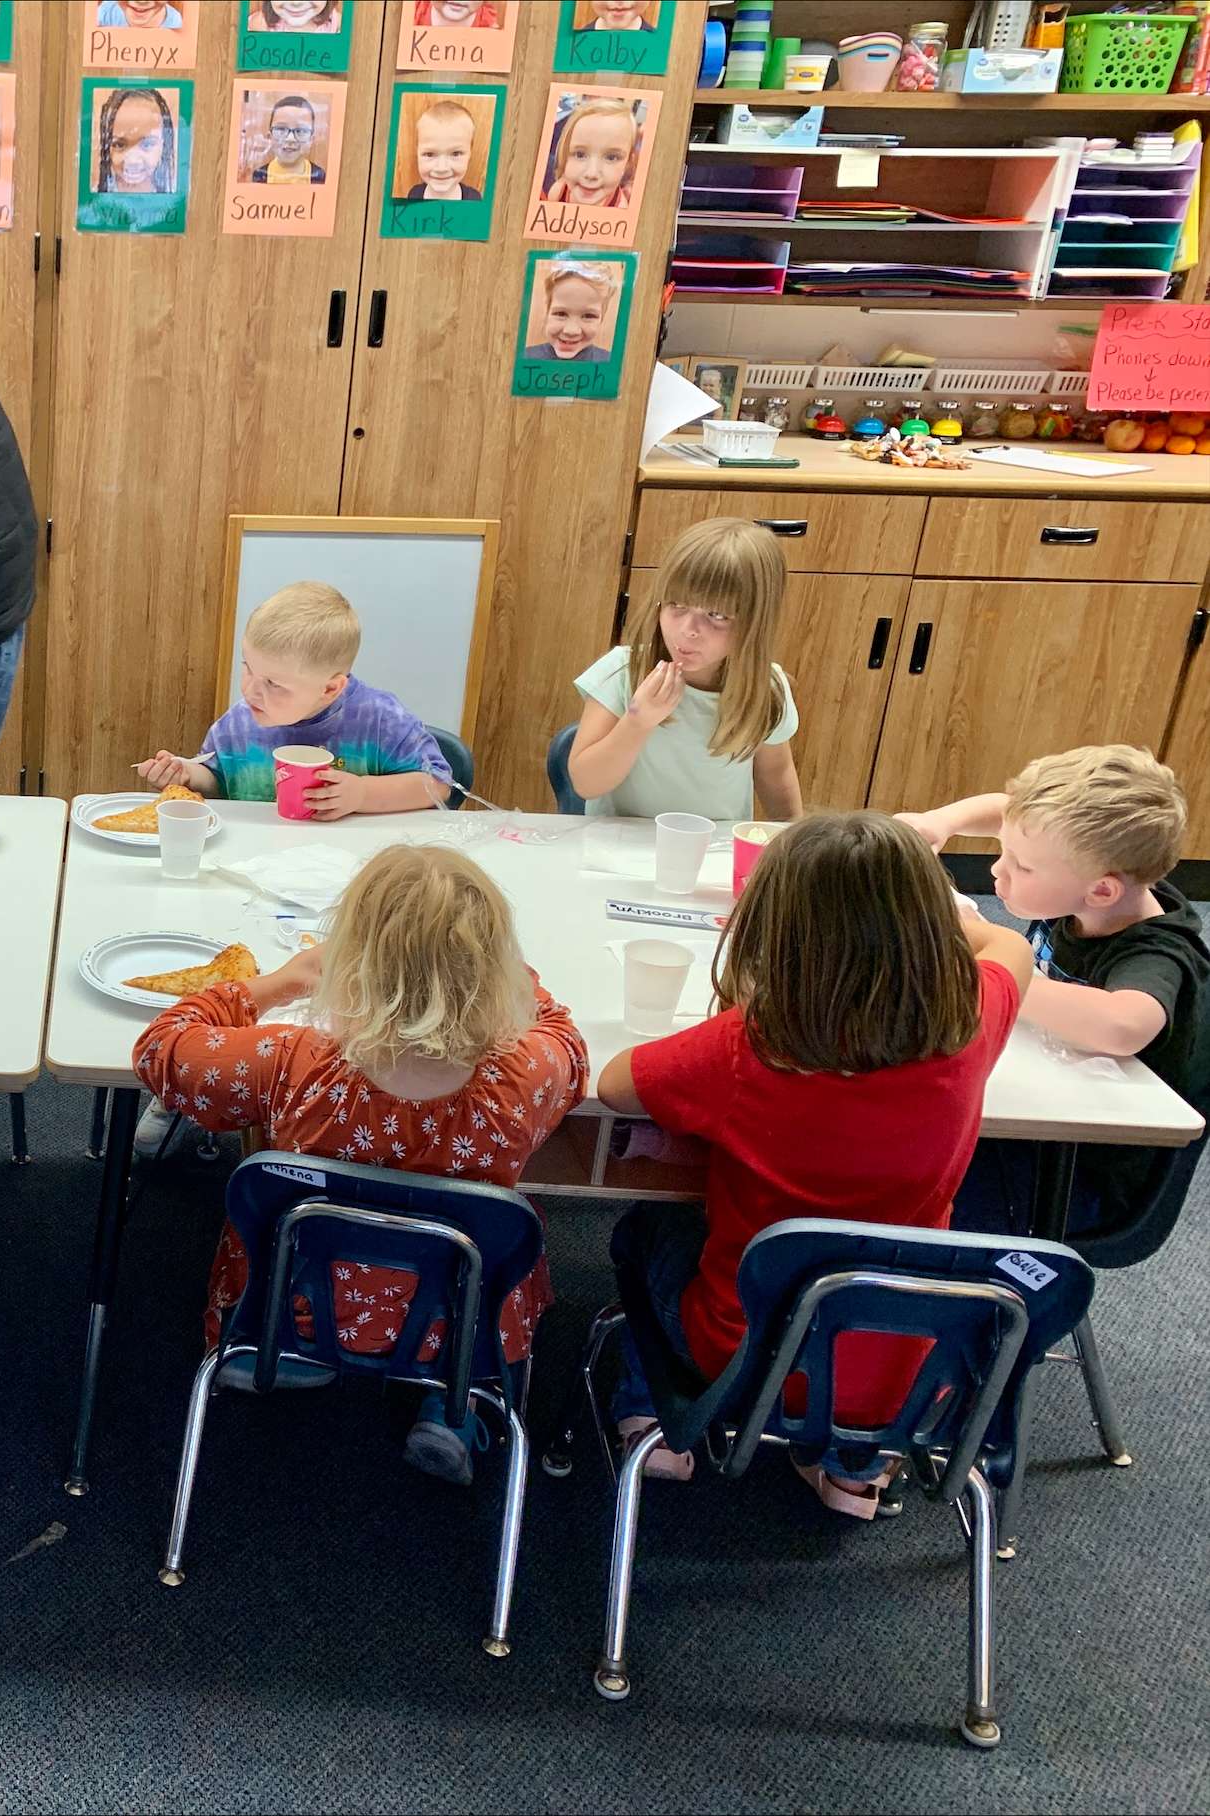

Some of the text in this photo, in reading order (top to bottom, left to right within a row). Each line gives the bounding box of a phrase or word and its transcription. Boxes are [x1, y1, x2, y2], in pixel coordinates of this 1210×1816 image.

[90, 30, 179, 69] Phenyx
[241, 35, 333, 69] Rosalee
[410, 30, 485, 65] Kenia
[569, 32, 647, 73] Kolby
[230, 192, 316, 221] Samuel
[391, 201, 455, 235] Kirk
[529, 204, 628, 240] Addyson
[517, 364, 606, 398] Joseph
[1097, 381, 1143, 402] Please
[615, 906, 693, 921] Brooklyn
